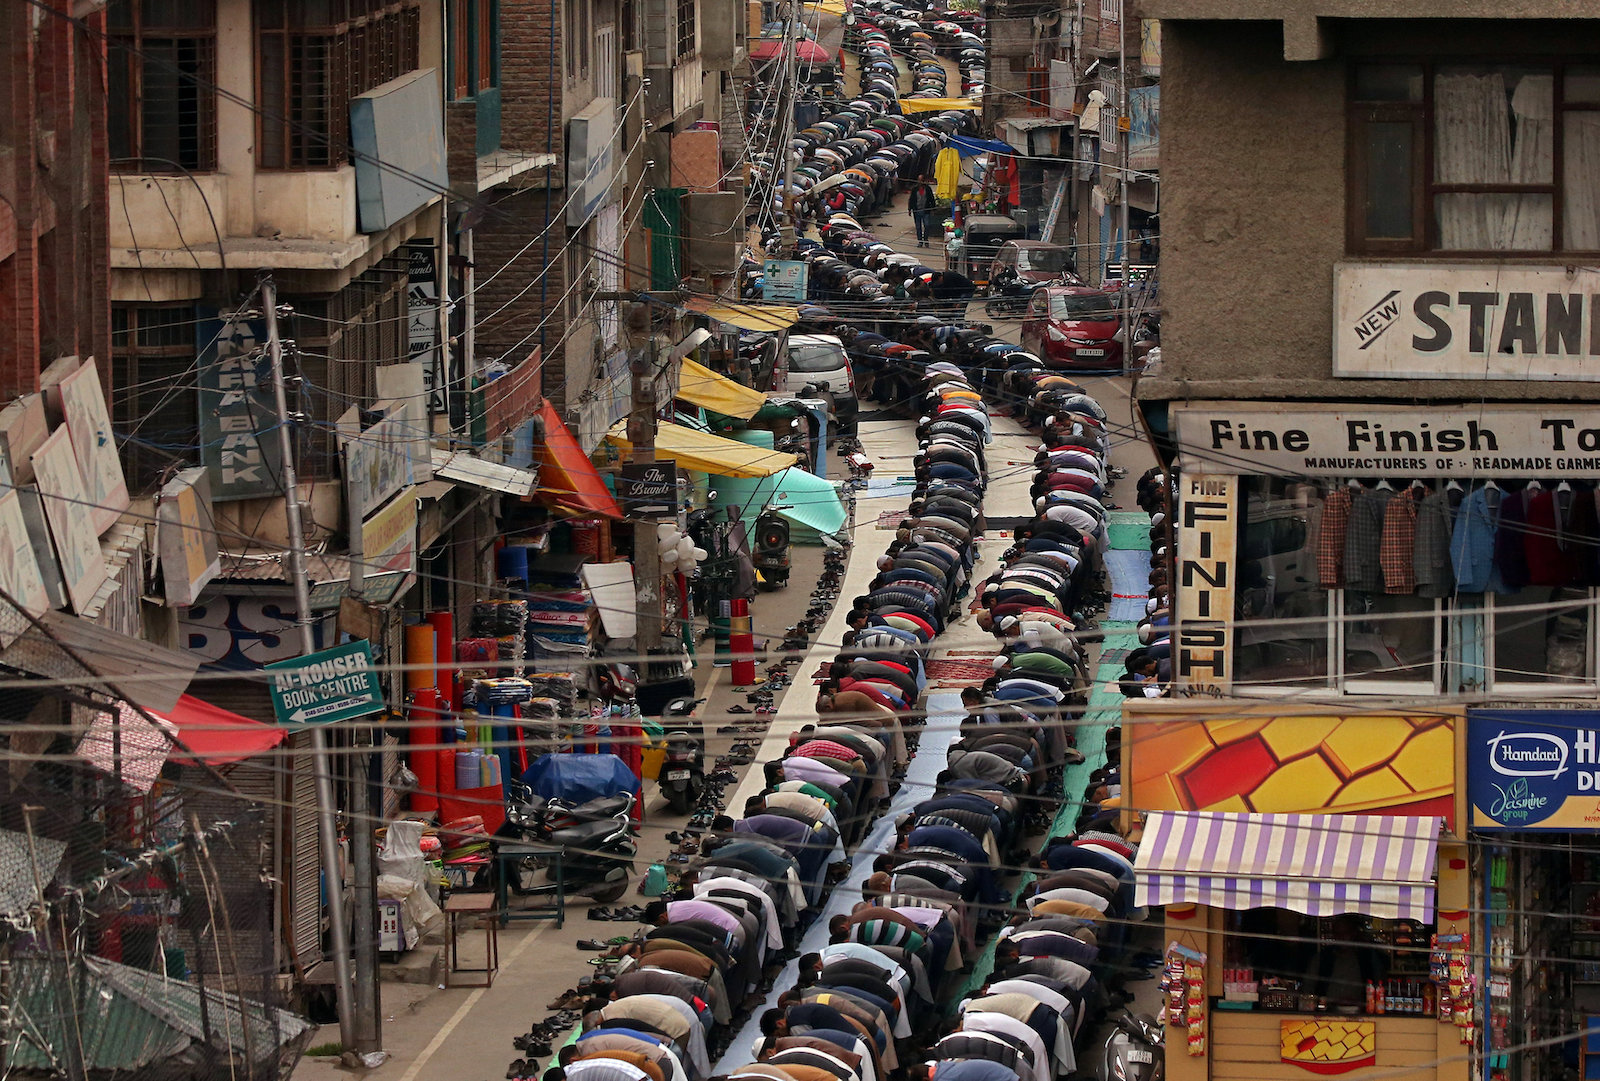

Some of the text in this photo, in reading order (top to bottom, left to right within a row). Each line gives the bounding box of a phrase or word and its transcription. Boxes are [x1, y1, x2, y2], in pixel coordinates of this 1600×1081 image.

[1354, 301, 1399, 340] NEW
[1210, 420, 1310, 451] Fine
[1346, 420, 1499, 452] Finish
[220, 415, 263, 484] BANK
[643, 468, 665, 482] The
[1304, 457, 1427, 470] MANUFACTURERS
[1436, 458, 1453, 470] OF
[1473, 457, 1552, 470] READMADE
[629, 481, 669, 496] Brands
[1191, 480, 1227, 496] FINE
[1180, 501, 1228, 677] FINISH
[282, 686, 319, 710] BOOK
[320, 673, 370, 700] CENTRE
[1502, 745, 1561, 762] Hamdard
[1490, 782, 1548, 817] Jasmine
[1503, 809, 1529, 823] group
